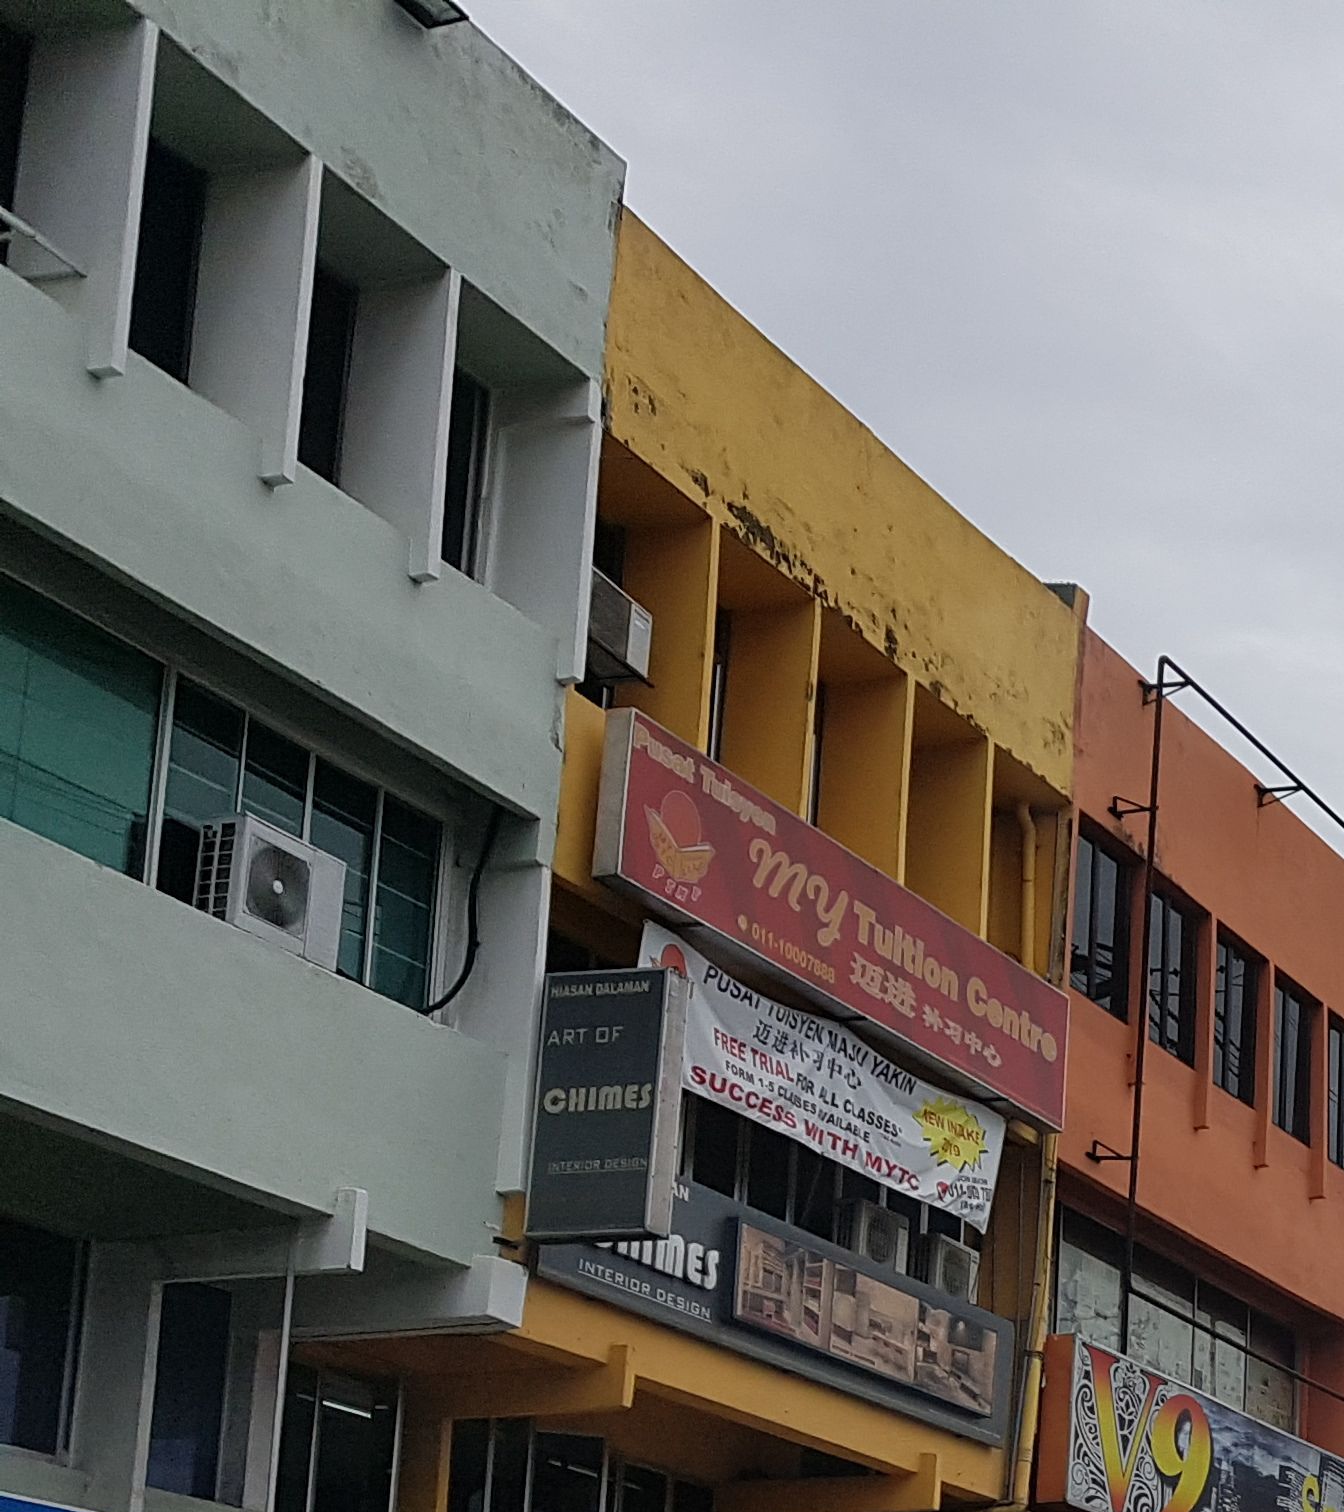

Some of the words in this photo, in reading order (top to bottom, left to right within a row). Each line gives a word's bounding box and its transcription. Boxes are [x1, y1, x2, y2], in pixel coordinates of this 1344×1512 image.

[633, 721, 695, 784] Pusat
[853, 899, 959, 1001] Tuition
[547, 1028, 588, 1046] ART
[594, 1025, 624, 1044] OF
[713, 1027, 748, 1063] FREE
[751, 1047, 795, 1084] TRIAL
[543, 1082, 654, 1115] CHIMES
[725, 1060, 755, 1085] FORM
[758, 1077, 775, 1093] 1-5
[870, 1057, 918, 1096] YAKIN
[690, 1065, 798, 1130] SUCCESS
[804, 1118, 860, 1160] WITH
[865, 1150, 921, 1191] MYTC
[603, 1157, 648, 1170] DESIGN
[579, 1258, 651, 1296] INTERIOR
[656, 1287, 711, 1320] DESIGN
